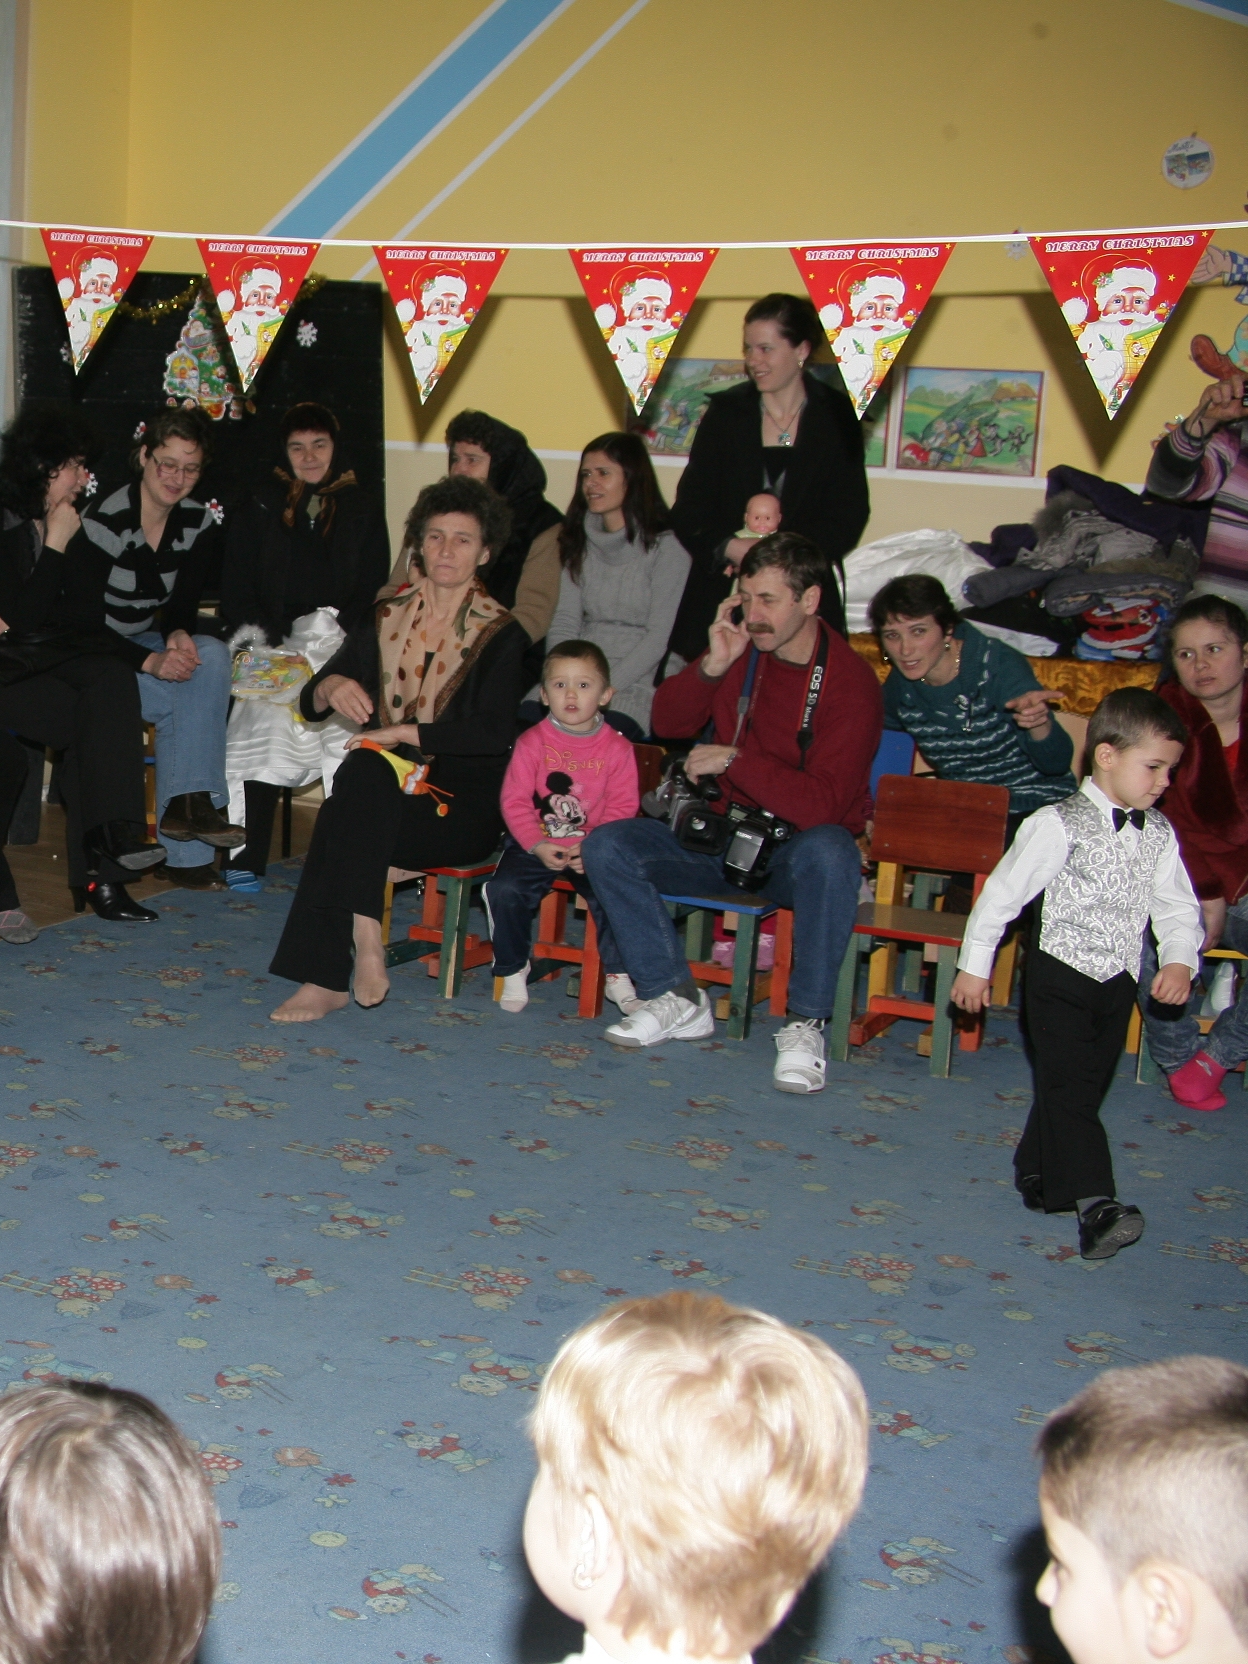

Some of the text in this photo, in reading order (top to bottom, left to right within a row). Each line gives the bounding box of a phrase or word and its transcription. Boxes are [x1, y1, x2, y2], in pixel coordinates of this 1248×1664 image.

[50, 232, 144, 248] MERRY CHRISTMAS
[1045, 235, 1195, 253] MERRY CHRISTMAS
[208, 243, 308, 256] MERRY CHRISTMAS
[386, 249, 496, 261] MERRY CHRISTMAS
[806, 247, 940, 261] MERRY CHRISTMAS
[582, 252, 704, 263] MERRY CHRISTMAS
[810, 665, 823, 690] EOS
